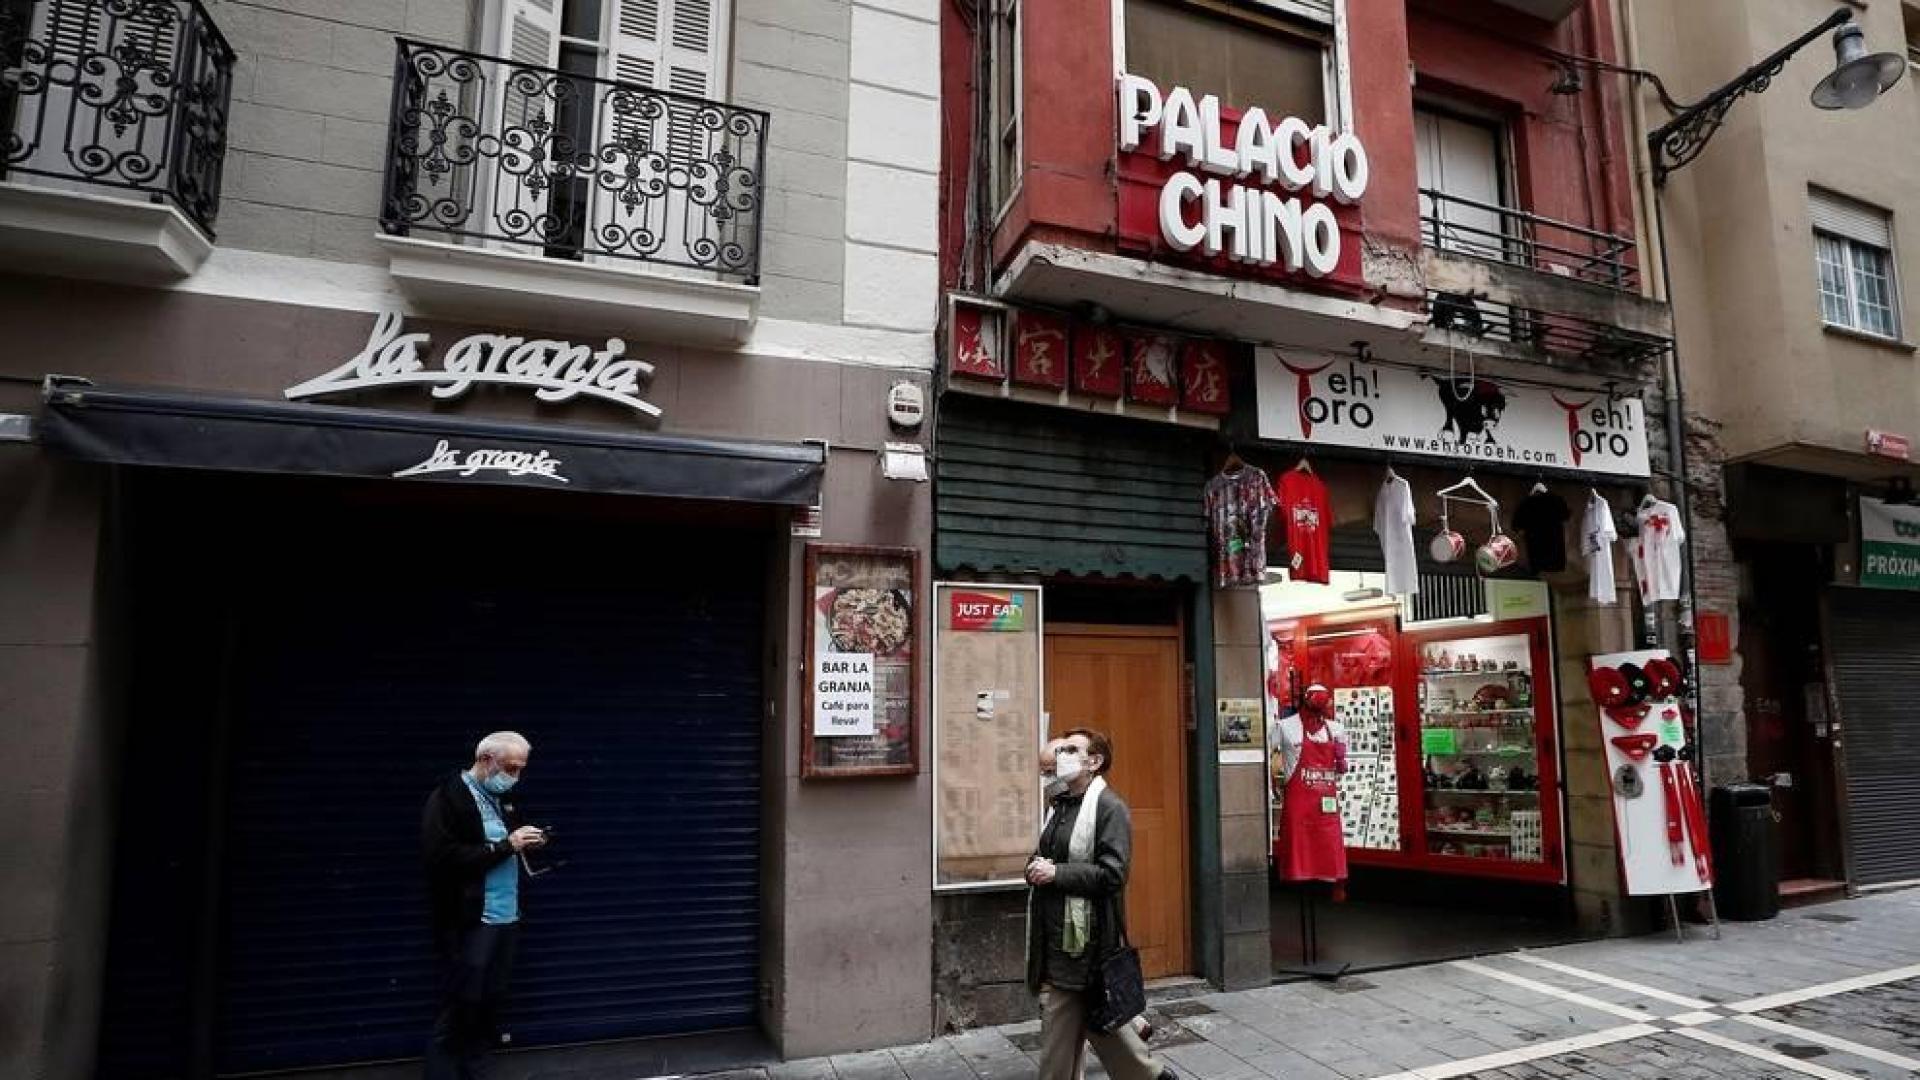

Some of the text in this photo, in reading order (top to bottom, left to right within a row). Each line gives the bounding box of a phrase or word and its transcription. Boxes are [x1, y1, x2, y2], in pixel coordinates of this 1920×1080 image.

[1118, 73, 1368, 203] PALACIO
[1159, 171, 1341, 277] CHINO
[328, 311, 657, 404] la granja
[1328, 362, 1381, 399] eh!
[1591, 398, 1634, 431] eh!
[460, 448, 565, 478] granja
[957, 603, 1020, 618] JUST EAT
[822, 662, 869, 674] BAR LA
[818, 680, 872, 693] GRANJA
[821, 700, 870, 713] Café para
[831, 715, 859, 726] llevar
